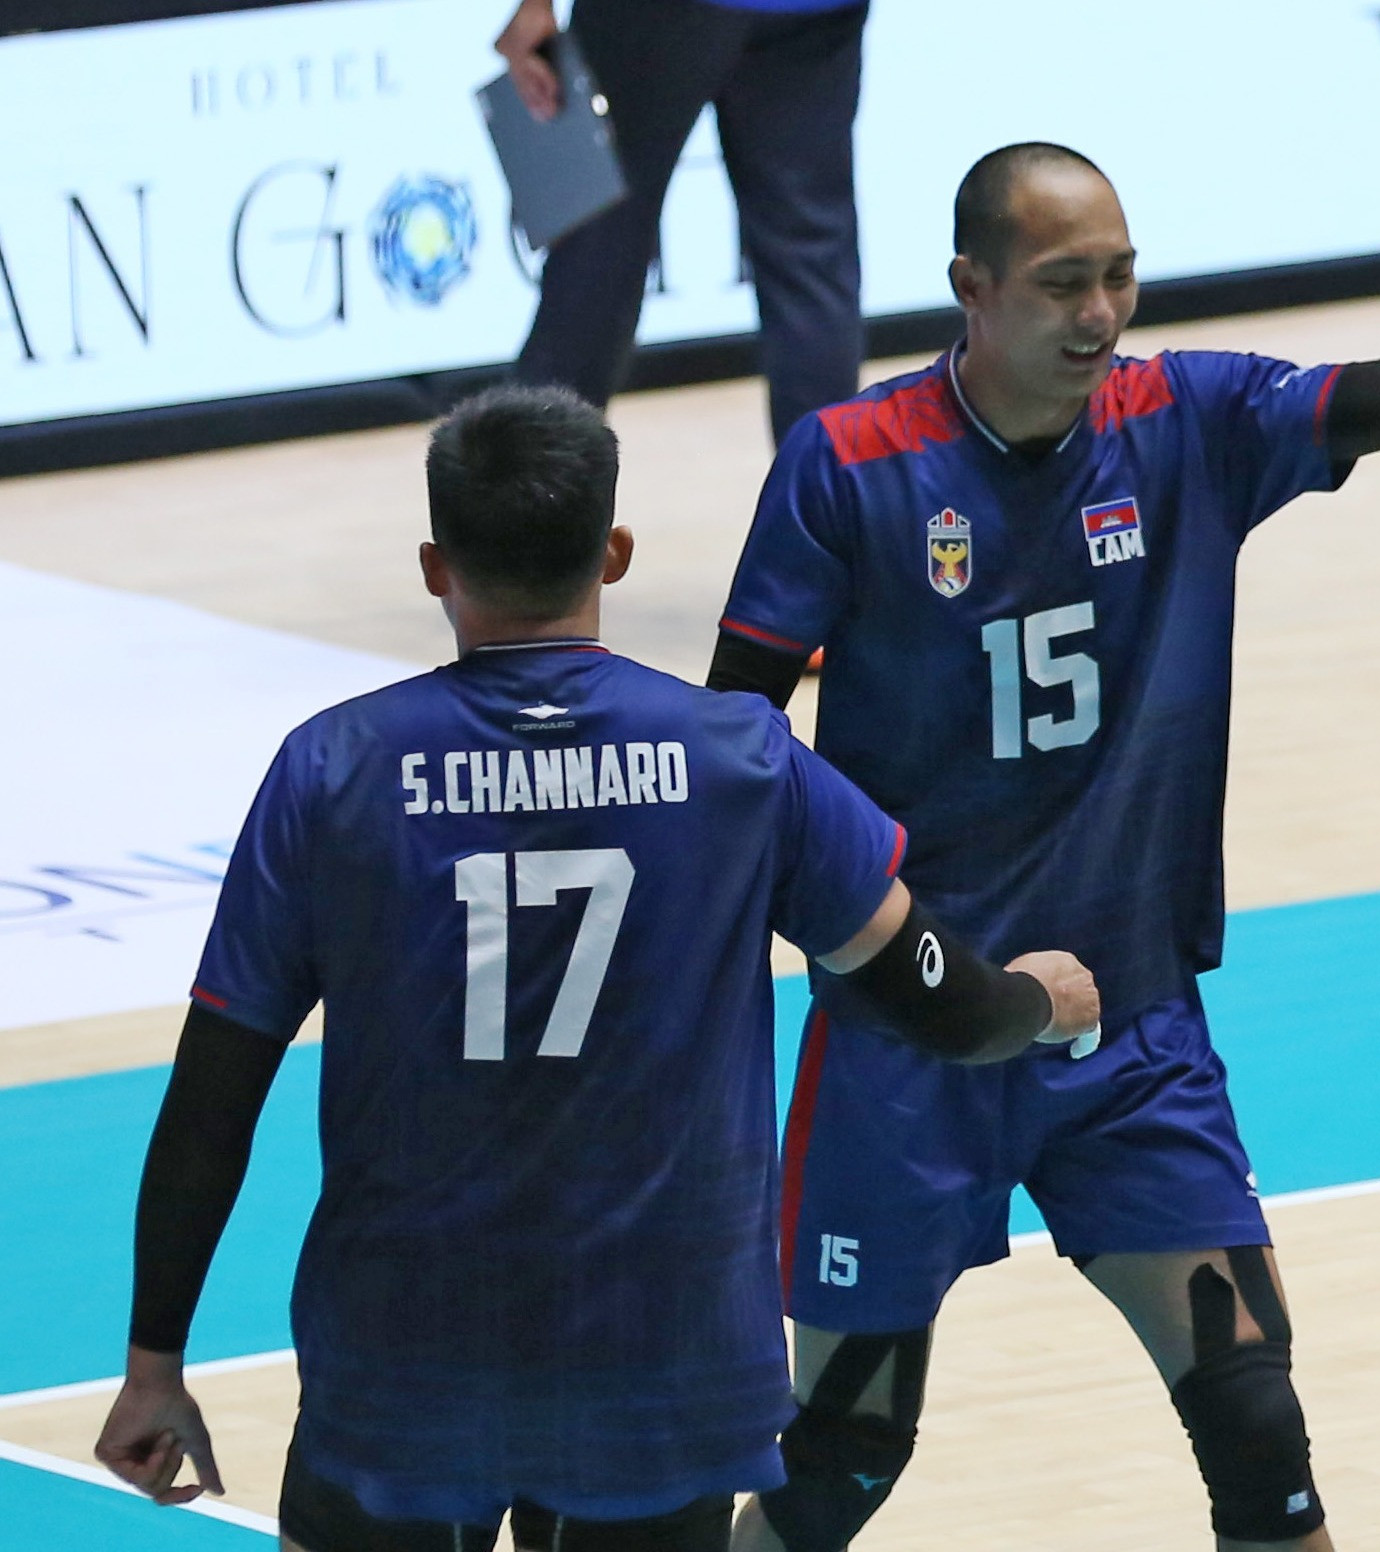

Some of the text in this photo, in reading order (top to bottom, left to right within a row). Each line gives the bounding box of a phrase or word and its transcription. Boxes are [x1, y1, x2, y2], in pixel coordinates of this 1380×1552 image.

[191, 52, 400, 114] HOTEL
[1087, 530, 1146, 567] CAM
[981, 601, 1100, 759] 15
[512, 721, 576, 731] FORWARD
[401, 741, 689, 815] S.CHANNARO
[455, 848, 635, 1060] 17
[819, 1233, 859, 1287] 15
